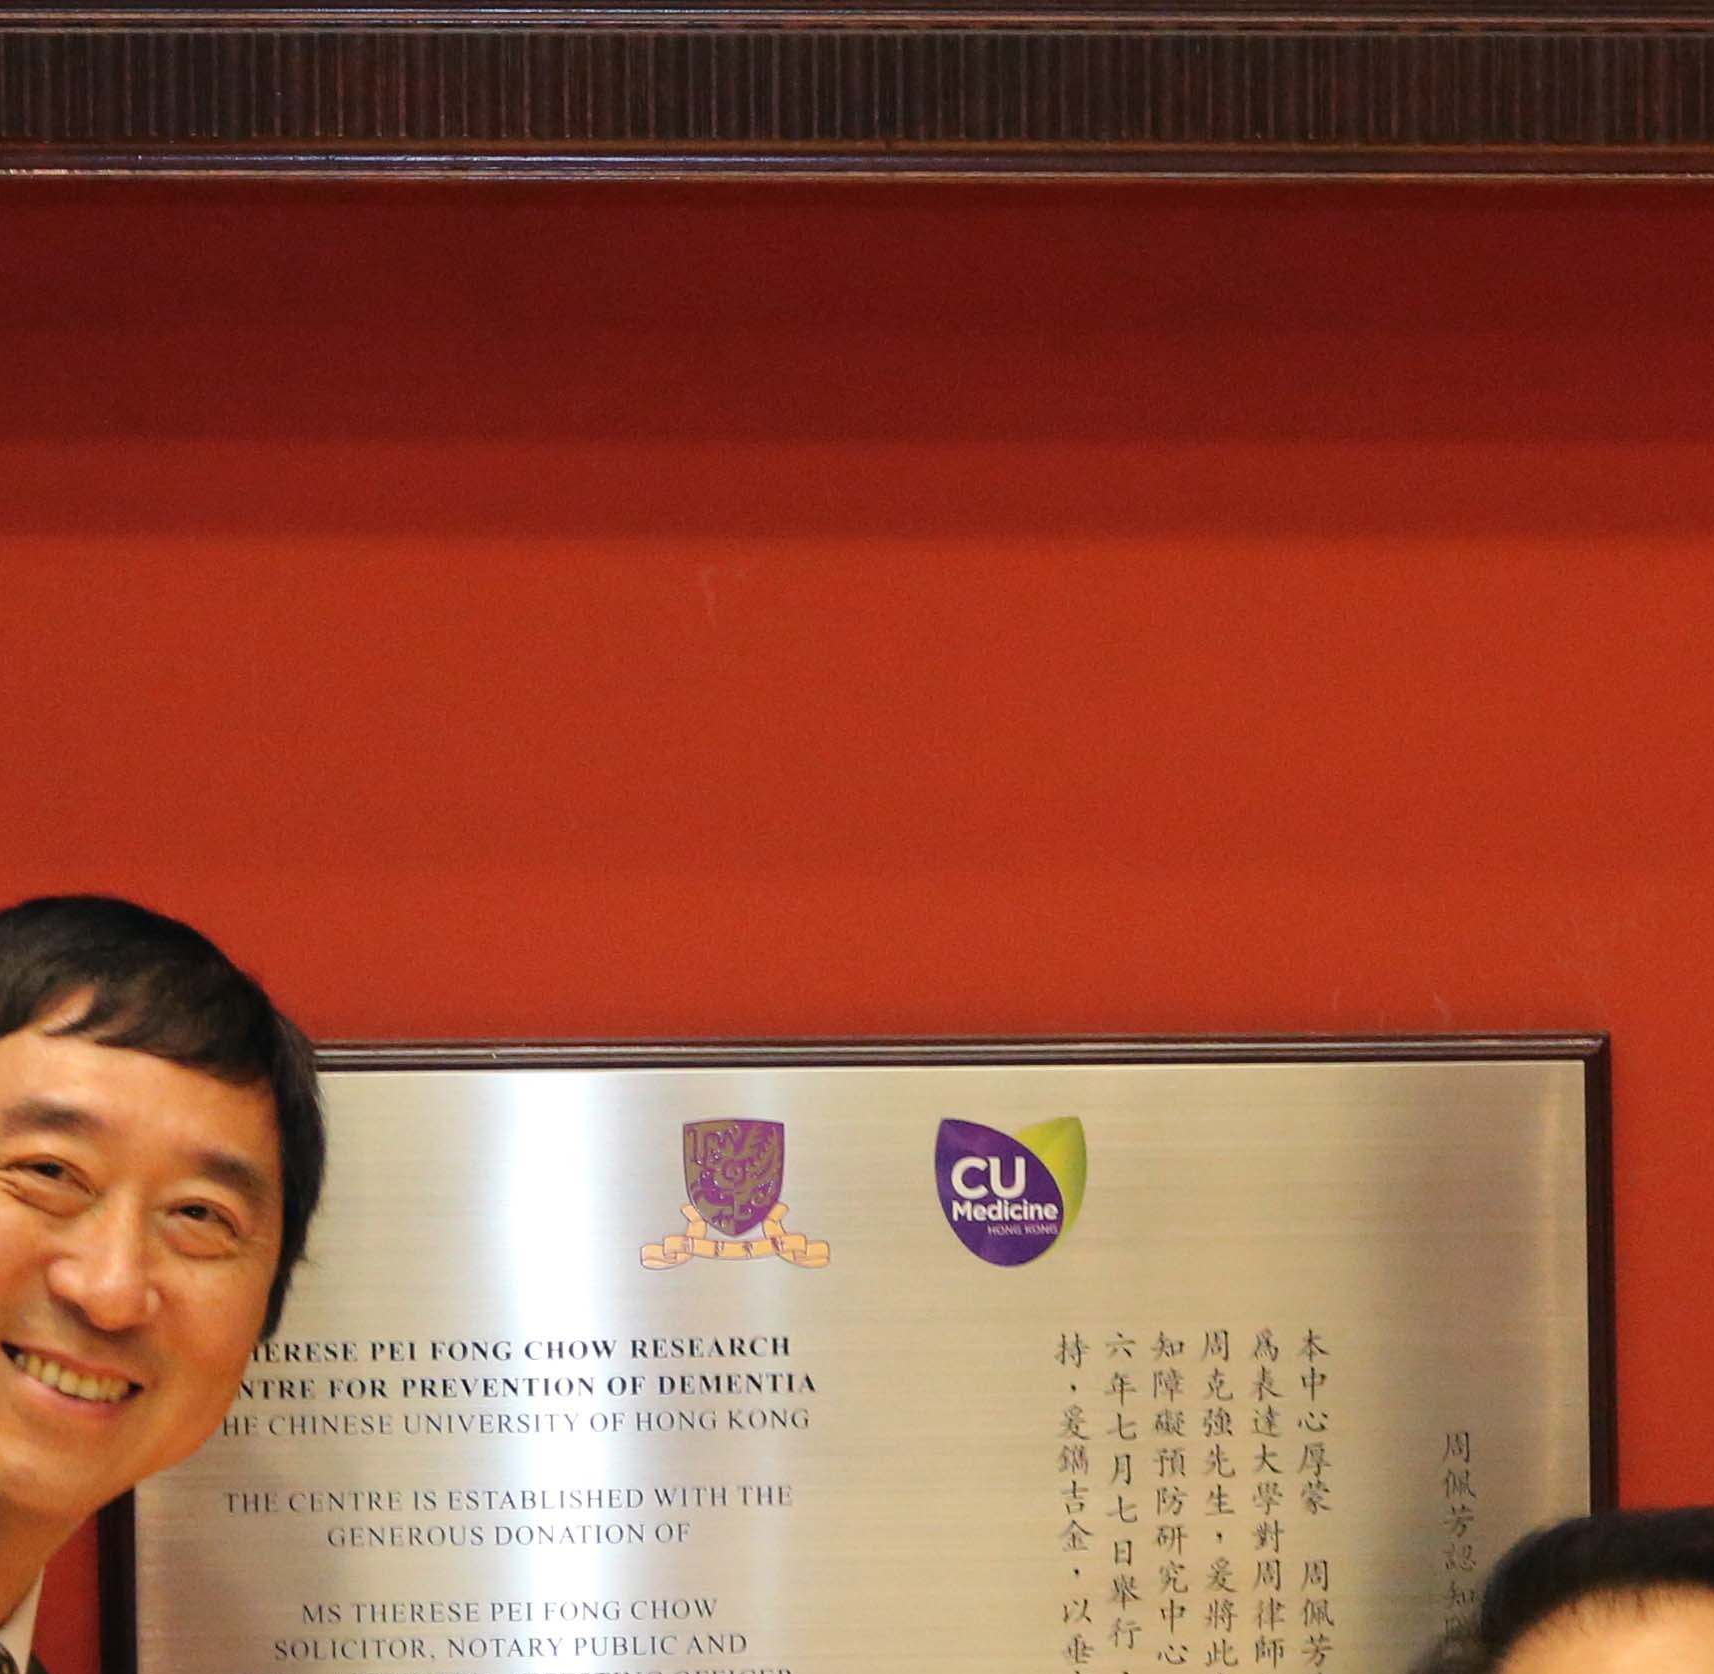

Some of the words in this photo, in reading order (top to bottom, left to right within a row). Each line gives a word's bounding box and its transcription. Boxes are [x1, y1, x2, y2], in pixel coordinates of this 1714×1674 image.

[951, 1156, 1027, 1200] CU
[951, 1199, 1059, 1222] Medicine
[370, 1340, 416, 1363] PEI
[430, 1340, 512, 1362] FONG
[523, 1339, 617, 1361] CHOW
[630, 1335, 790, 1360] RESEARCH
[328, 1378, 388, 1400] FOR
[402, 1376, 594, 1399] PREVENTION
[606, 1375, 646, 1397] OF
[658, 1372, 817, 1396] DEMENTIA
[268, 1414, 393, 1436] CHINESE
[403, 1413, 579, 1436] UNIVERSITY
[589, 1411, 626, 1433] OF
[635, 1409, 717, 1433] HONG
[727, 1407, 810, 1431] KONG
[223, 1491, 279, 1514] THE
[288, 1490, 402, 1513] CENTRE
[413, 1489, 437, 1512] IS
[447, 1488, 644, 1511] ESTABLISHED
[653, 1485, 727, 1508] WITH
[736, 1484, 793, 1507] THE
[326, 1525, 484, 1548] GENEROUS
[494, 1523, 645, 1546] DONATION
[654, 1521, 691, 1544] OF
[301, 1603, 342, 1625] MS
[352, 1601, 481, 1624] THERESE
[489, 1601, 533, 1623] PEI
[543, 1600, 621, 1622] FONG
[630, 1597, 718, 1621] CHOW
[446, 1637, 563, 1659] NOTARY
[574, 1634, 678, 1657] PUBLIC
[686, 1632, 748, 1656] AND
